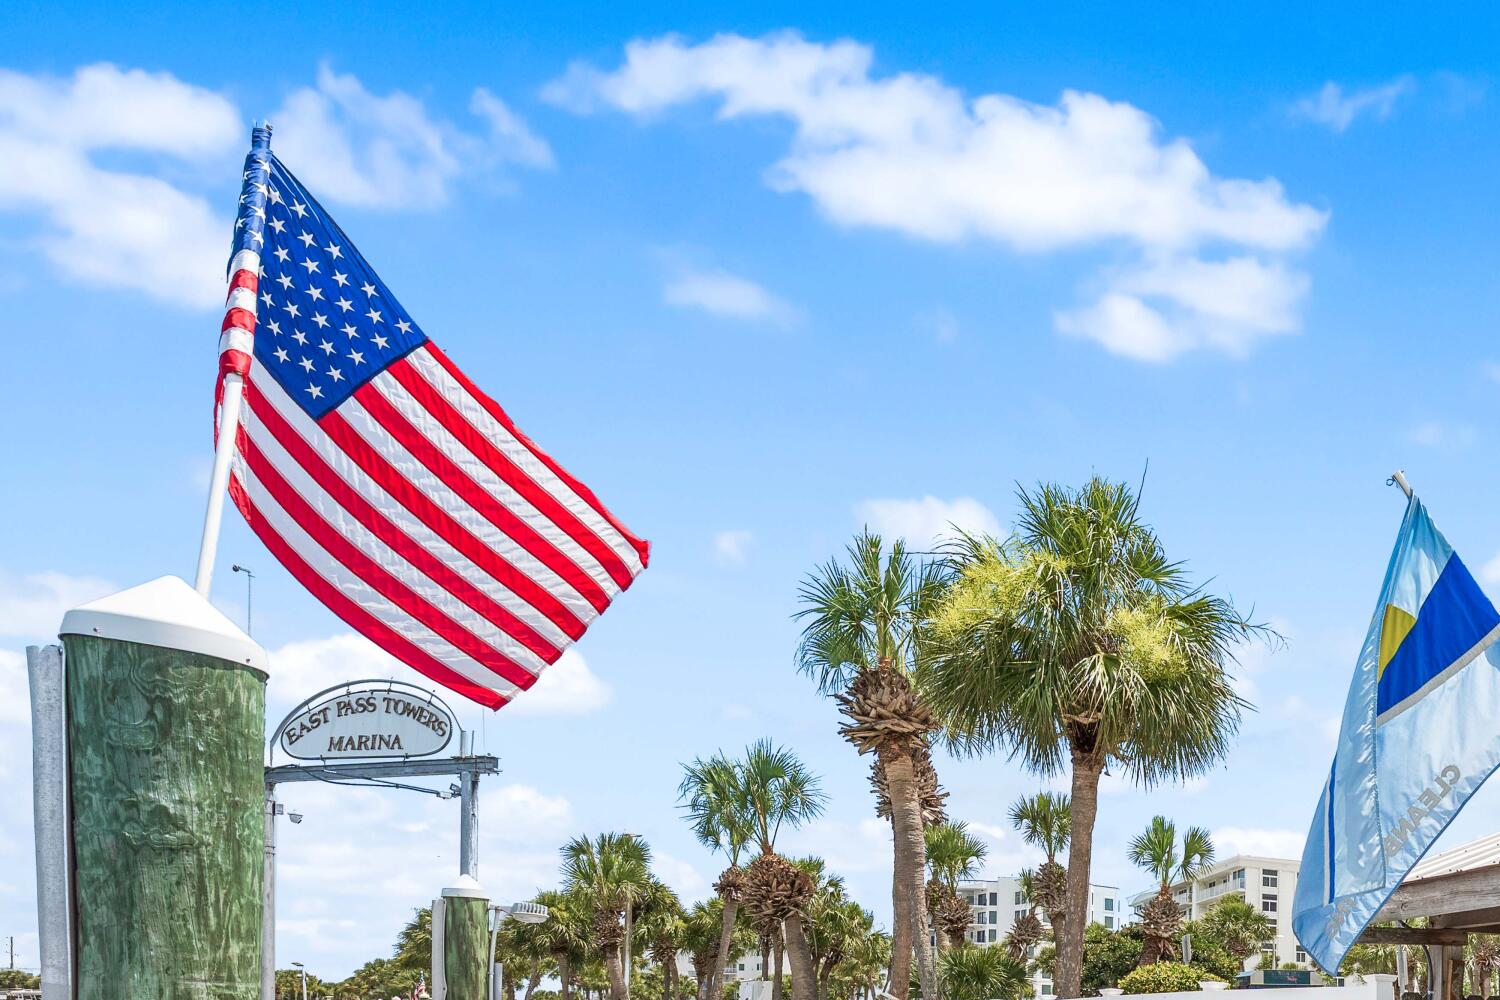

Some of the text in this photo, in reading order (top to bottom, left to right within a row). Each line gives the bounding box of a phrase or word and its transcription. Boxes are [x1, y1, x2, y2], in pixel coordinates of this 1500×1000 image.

[285, 696, 448, 746] EAST PASS TOWERS
[328, 734, 404, 752] MARINA
